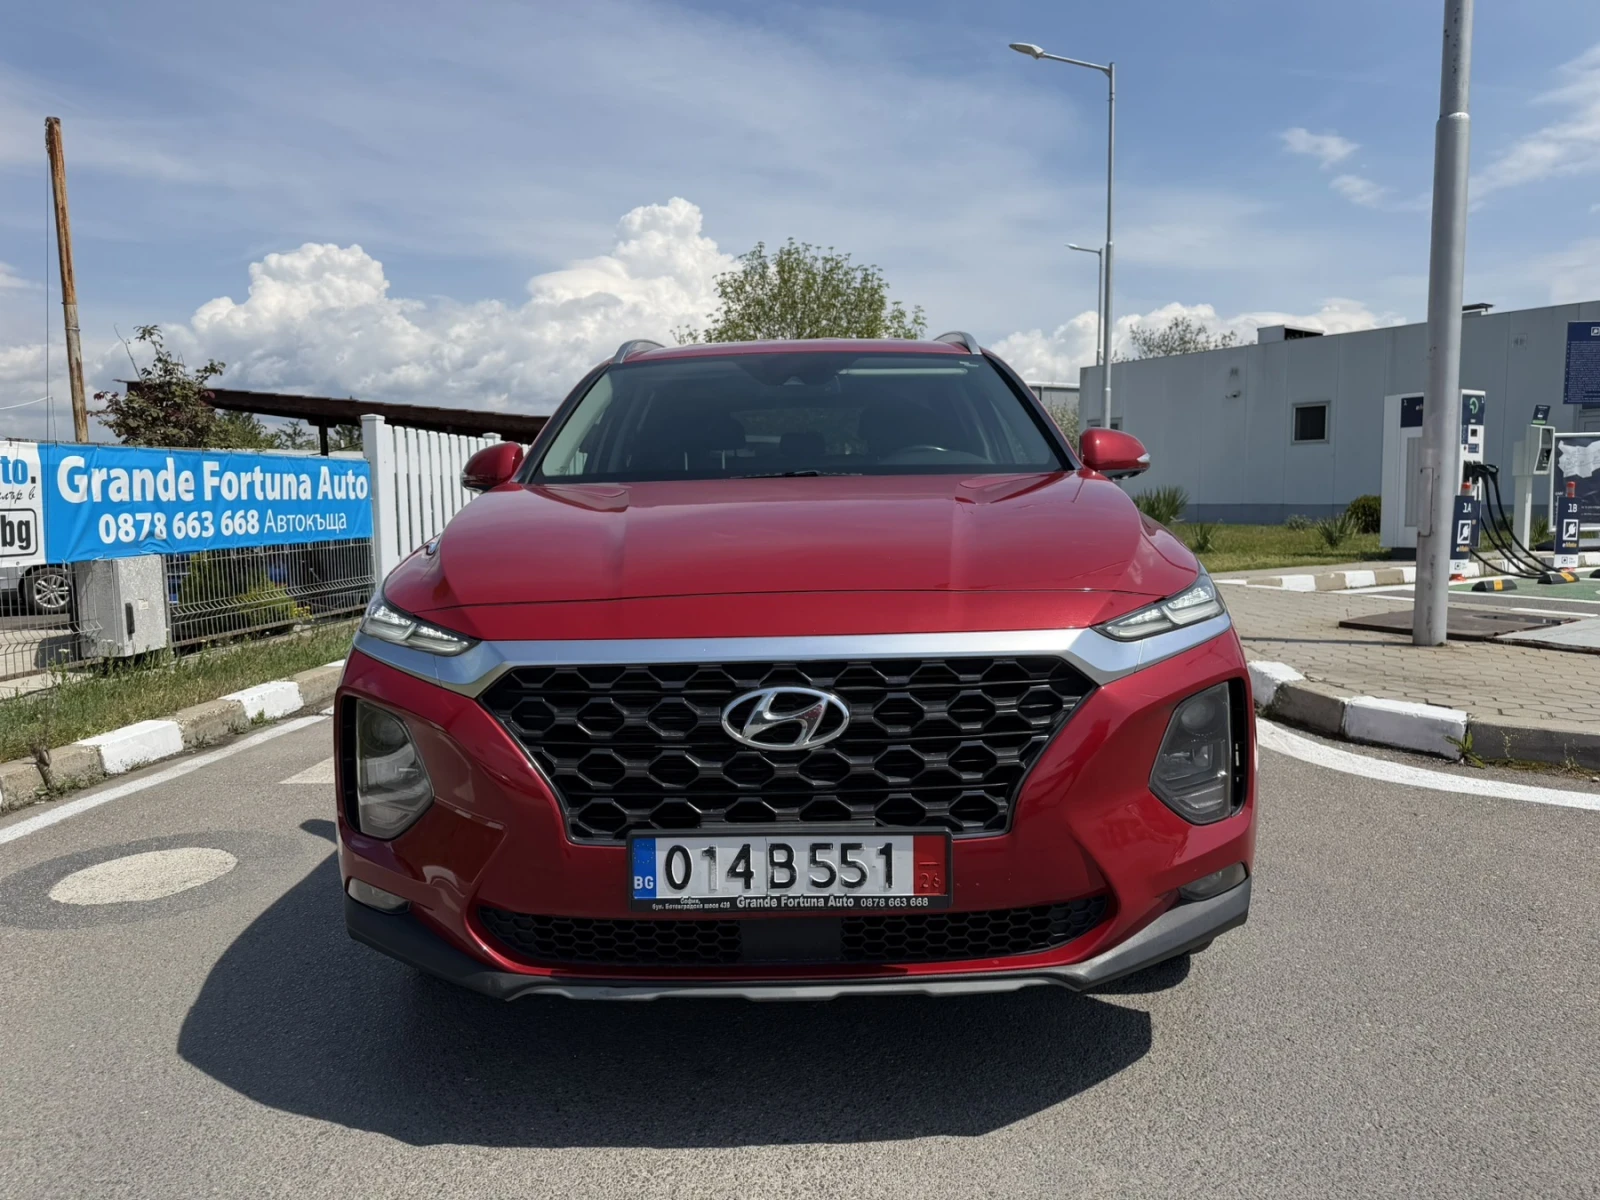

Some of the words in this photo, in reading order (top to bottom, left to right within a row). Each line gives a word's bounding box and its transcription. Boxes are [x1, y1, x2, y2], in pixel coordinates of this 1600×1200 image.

[57, 455, 195, 504] Grande
[203, 461, 312, 501] Fortuna
[317, 466, 369, 500] Auto
[1567, 503, 1578, 513] 1B
[99, 511, 167, 544] 0878
[172, 510, 215, 540] 663
[220, 509, 259, 537] 668
[264, 508, 347, 534] Автокъща
[634, 876, 654, 890] BG
[736, 895, 778, 908] Grande
[781, 894, 825, 907] Fortuna
[828, 893, 854, 907] Auto
[860, 898, 885, 907] 0878
[888, 898, 907, 907] 663
[910, 897, 929, 907] 668
